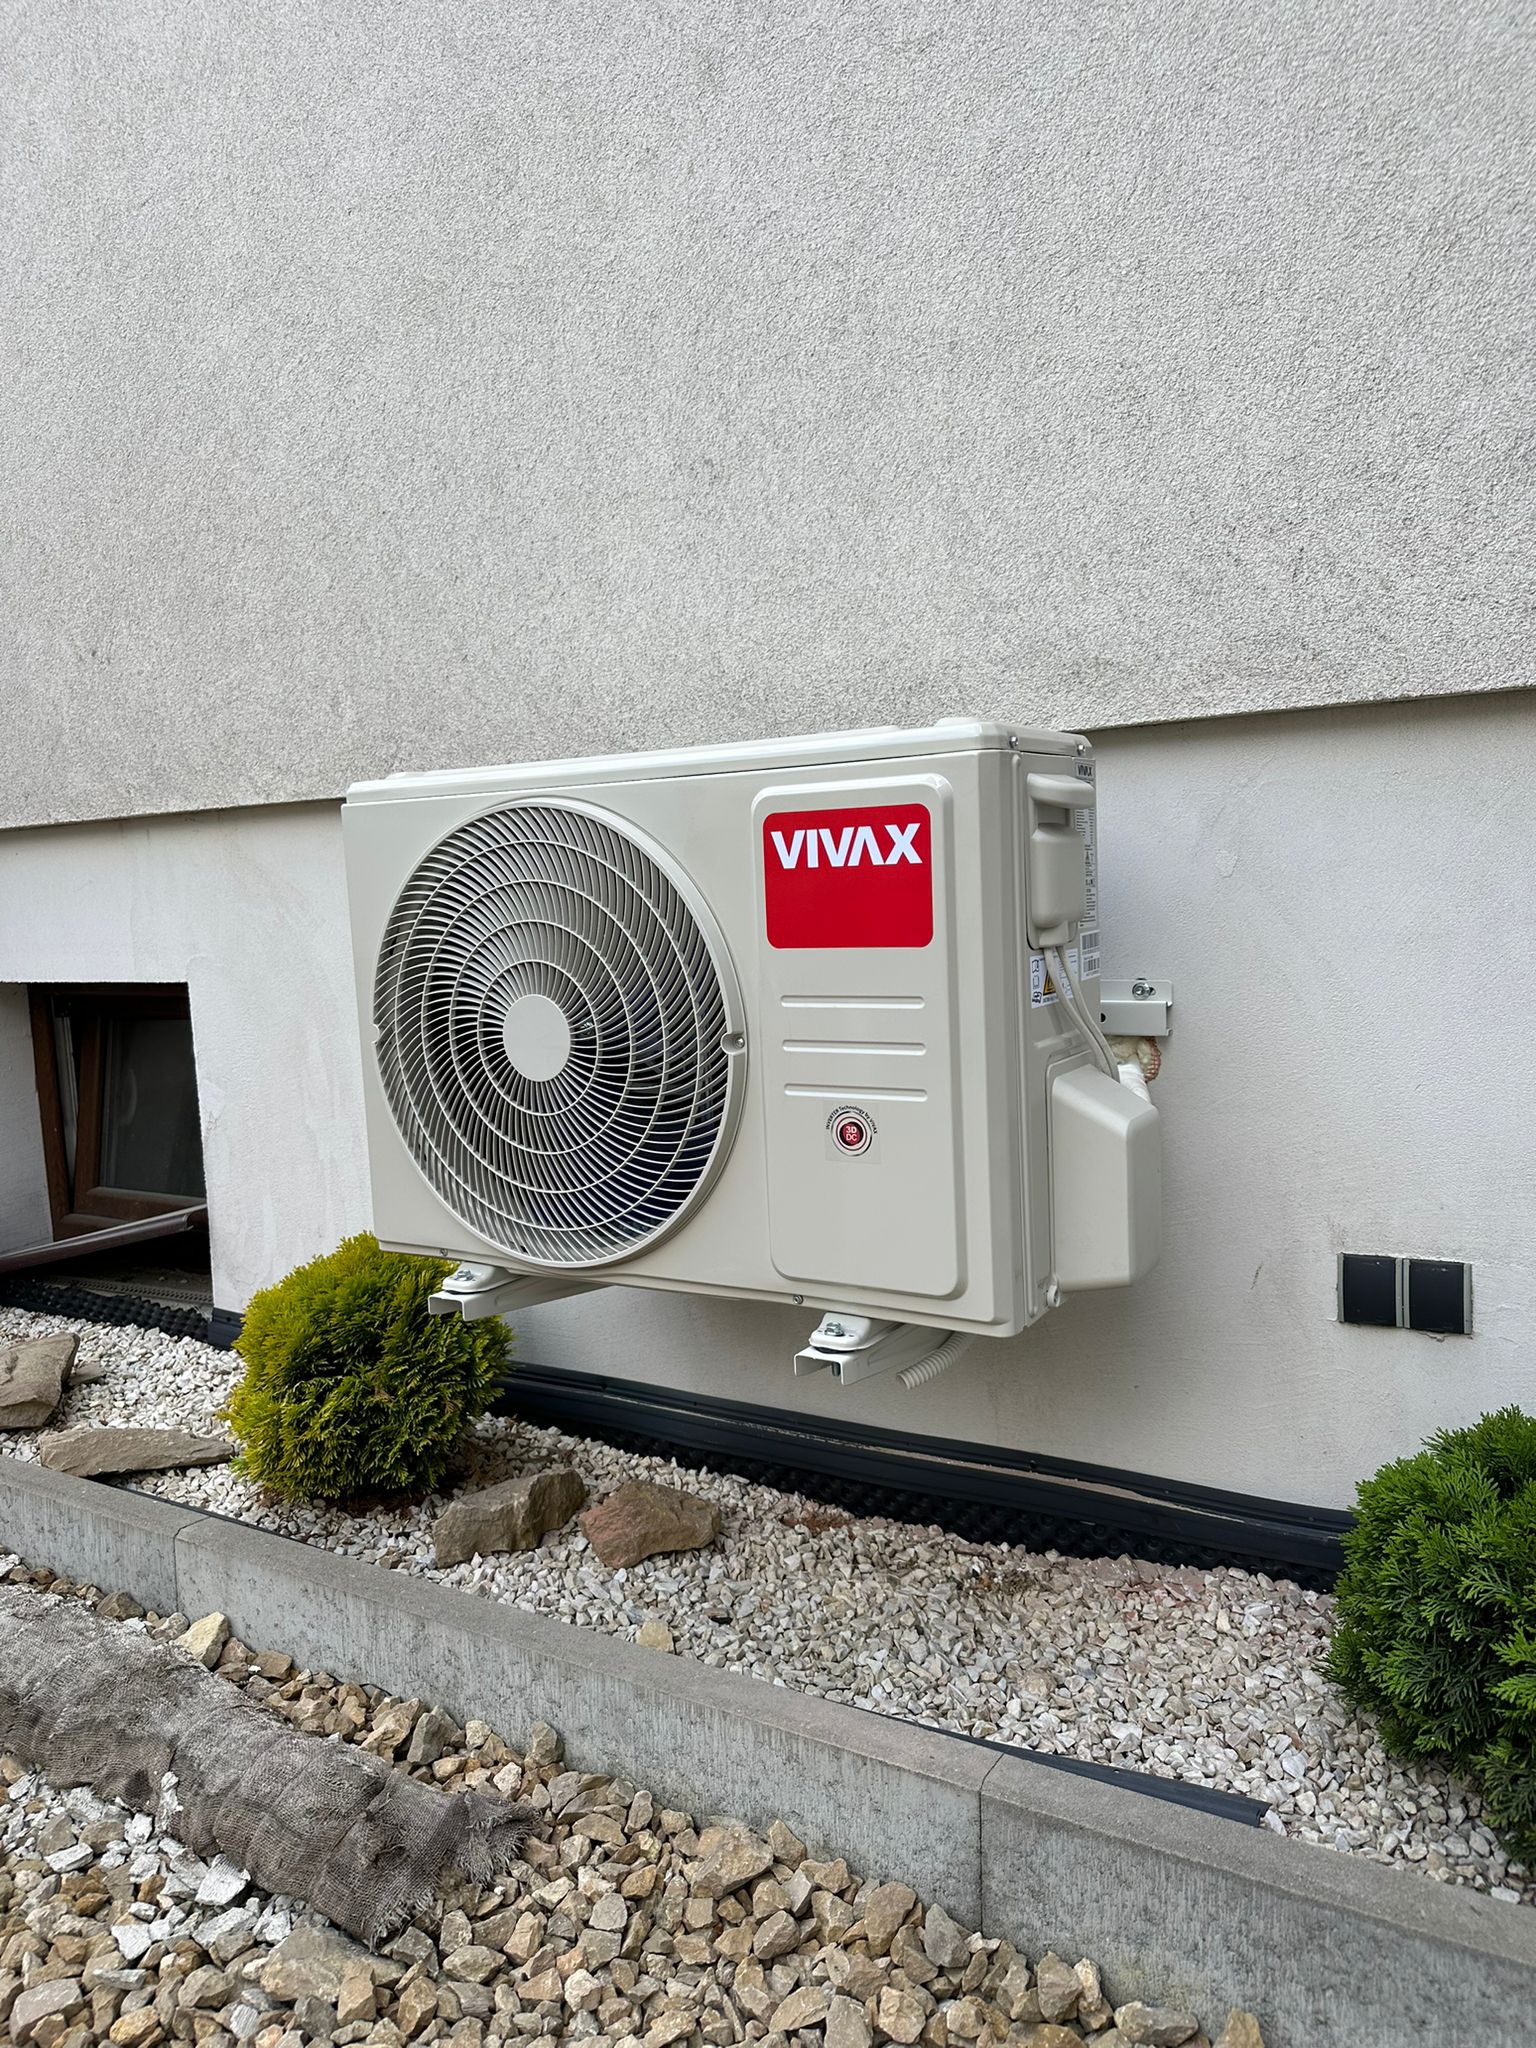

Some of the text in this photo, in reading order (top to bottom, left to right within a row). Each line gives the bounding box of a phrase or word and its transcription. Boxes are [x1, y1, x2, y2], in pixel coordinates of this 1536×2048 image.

[770, 823, 923, 869] VIVAX
[826, 1109, 839, 1130] INVERTER
[839, 1105, 864, 1115] Technology
